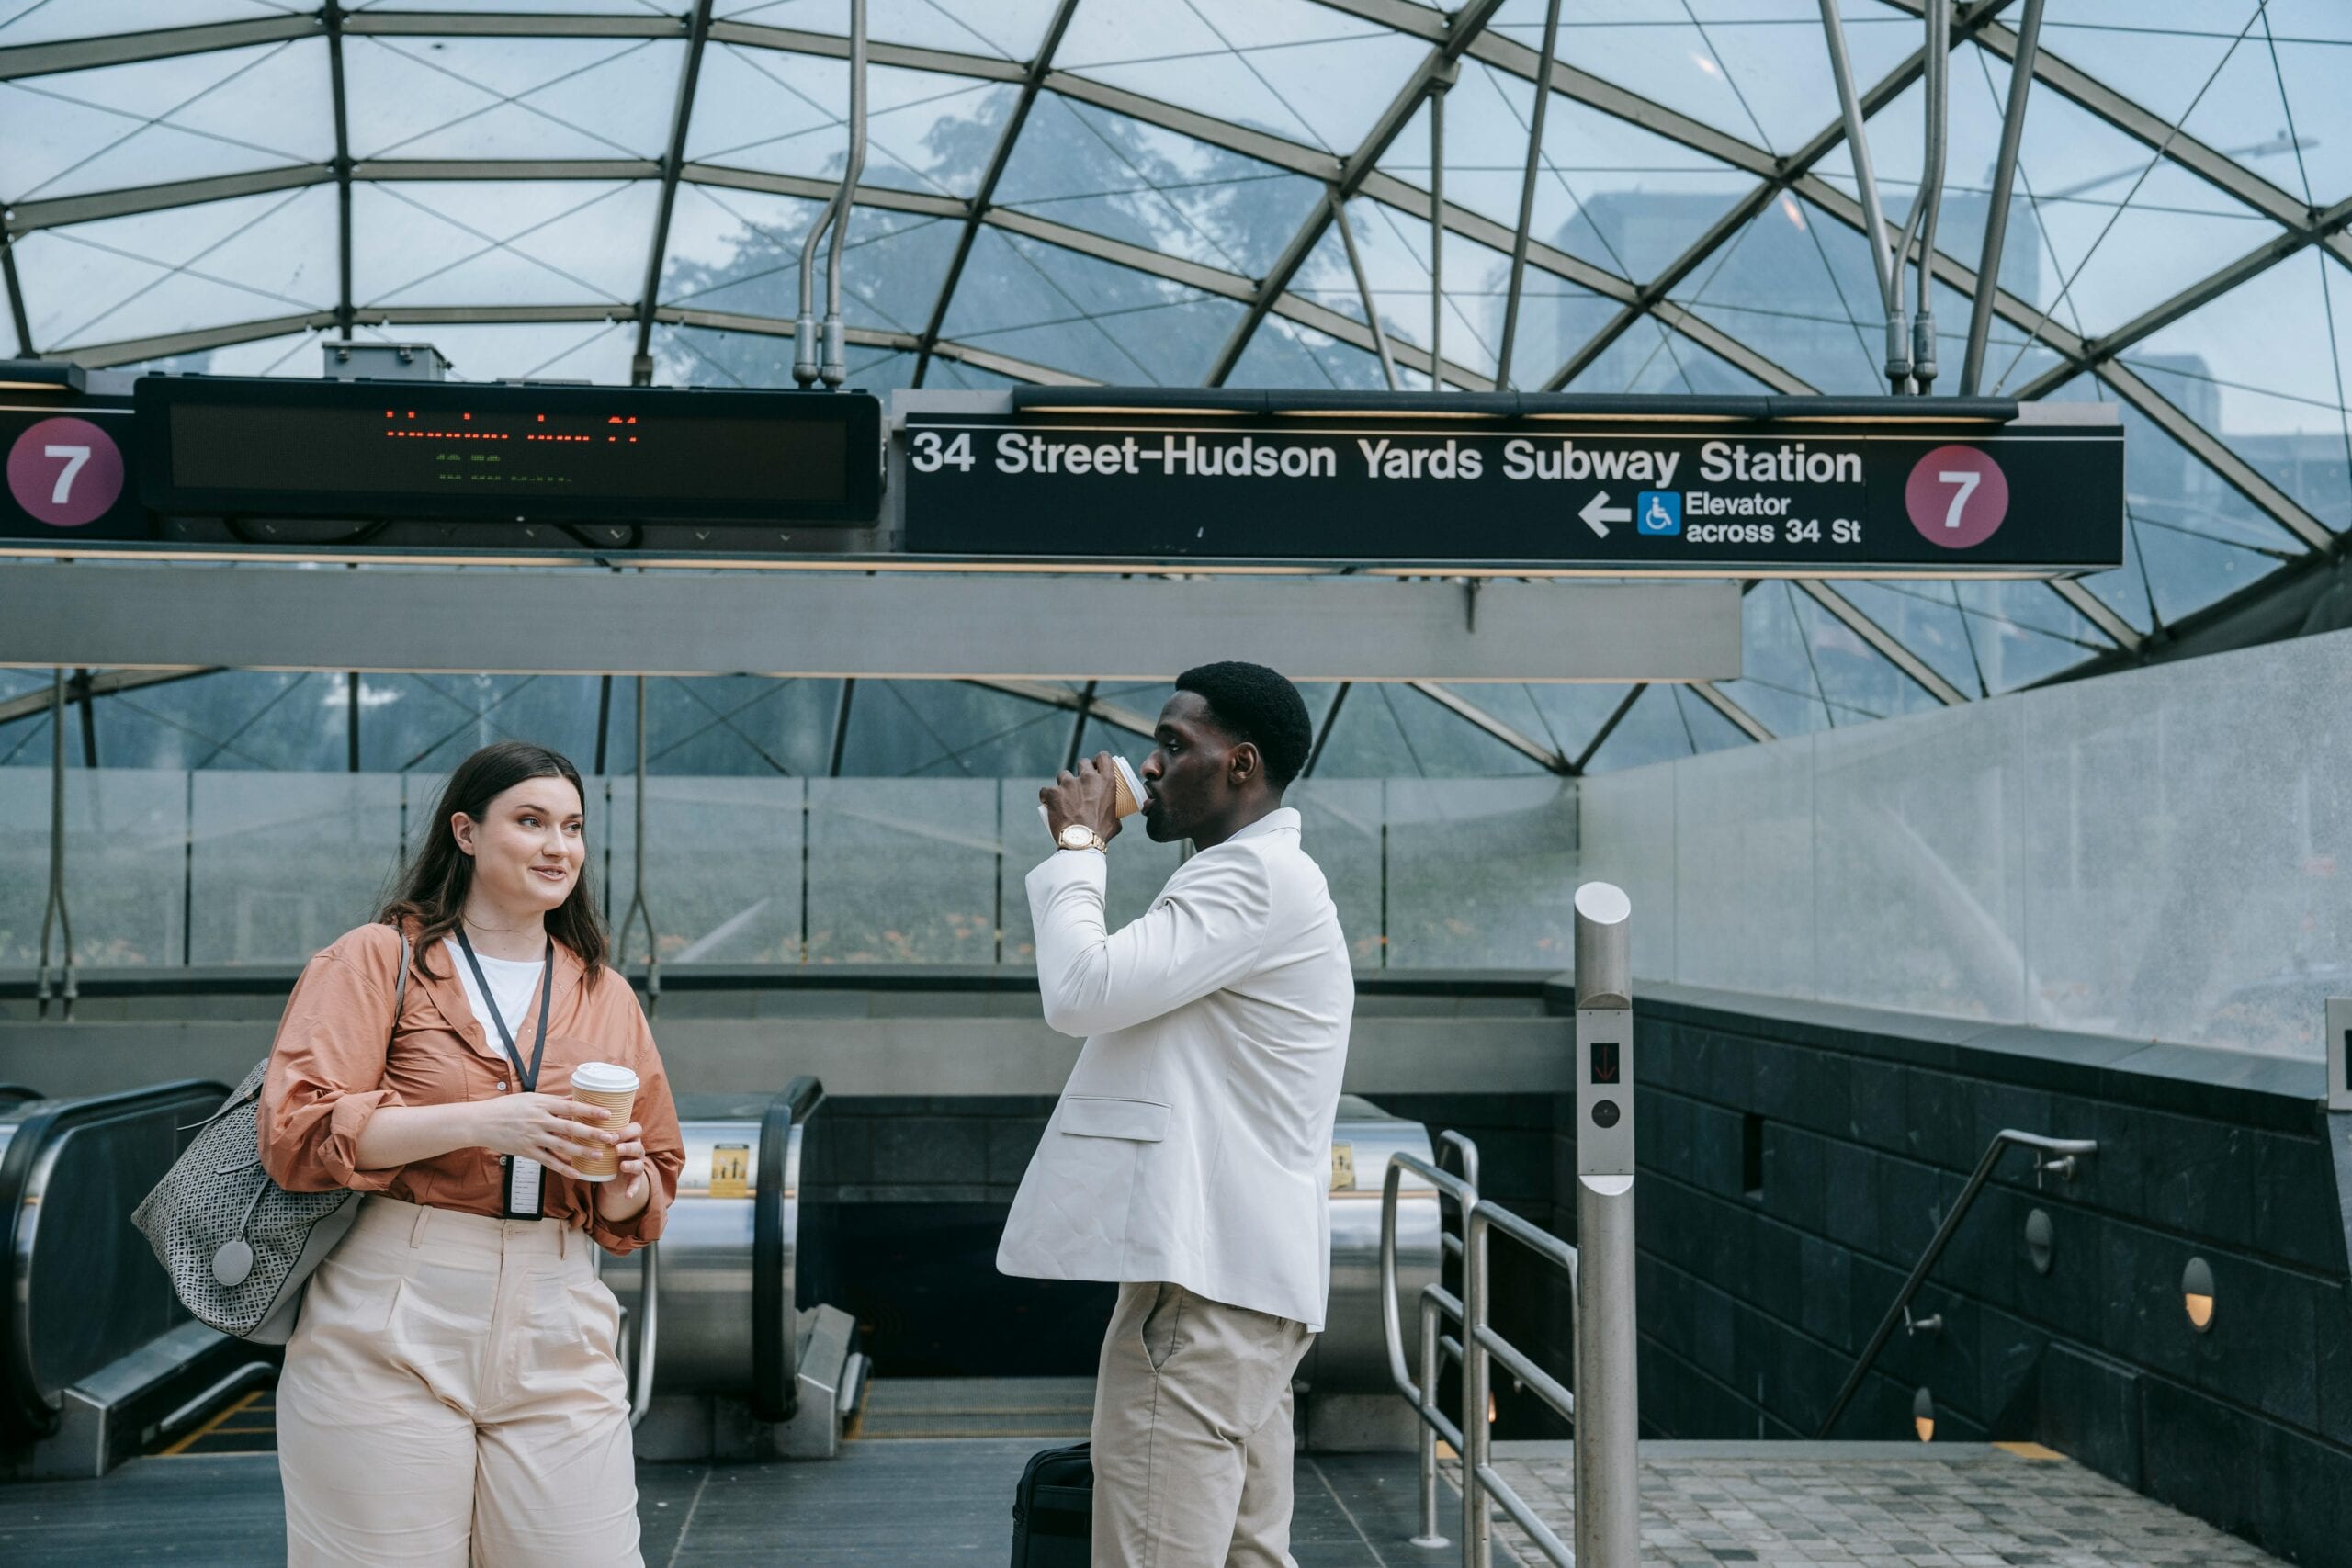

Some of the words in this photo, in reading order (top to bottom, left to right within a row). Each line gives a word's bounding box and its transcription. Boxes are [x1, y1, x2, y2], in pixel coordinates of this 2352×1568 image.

[45, 446, 90, 503] 7
[912, 432, 976, 473] 34
[995, 433, 1336, 478] Street-Hudson
[1357, 439, 1483, 481] Yards
[1502, 439, 1680, 489] Subway
[1700, 441, 1861, 483] Station
[1686, 491, 1792, 516] Elevator
[1939, 471, 1980, 527] 7
[1686, 524, 1775, 544] across
[1785, 518, 1821, 544] 34
[1831, 518, 1861, 544] St
